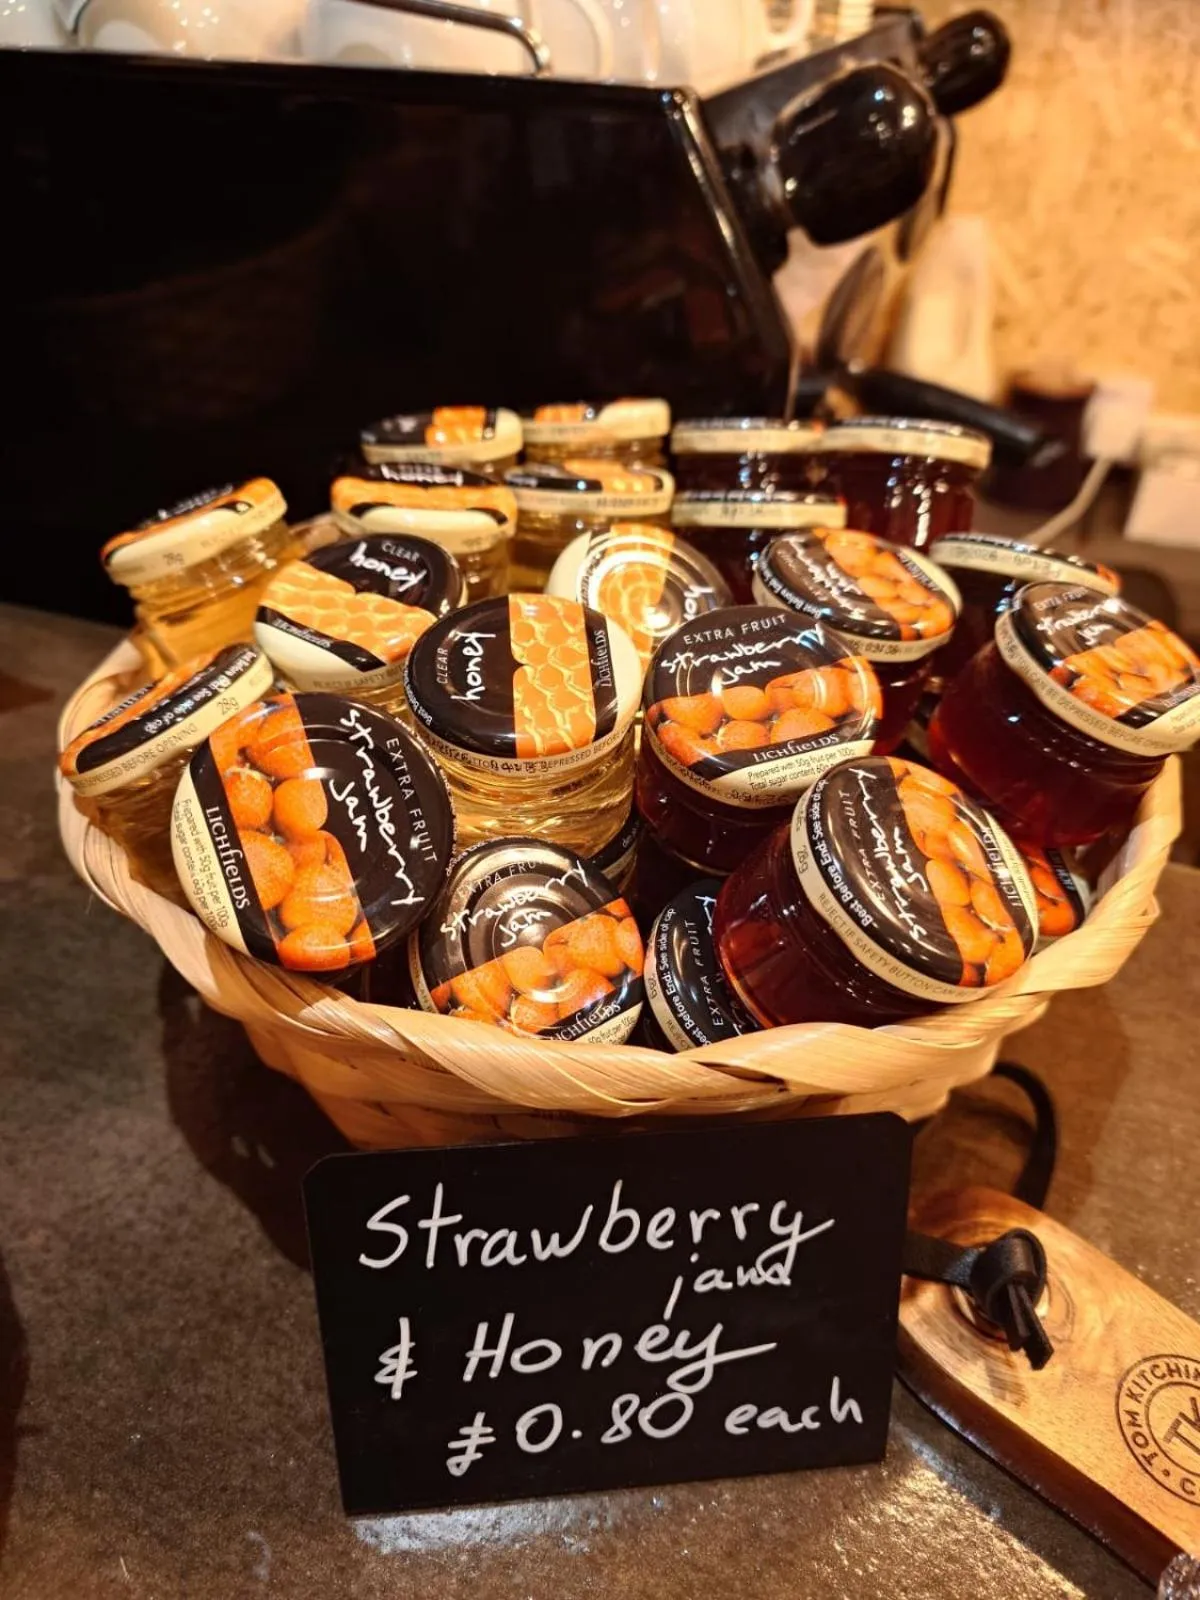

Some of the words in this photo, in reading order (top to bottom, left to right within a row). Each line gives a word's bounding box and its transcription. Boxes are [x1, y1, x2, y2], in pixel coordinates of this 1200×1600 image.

[350, 541, 427, 593] honey
[381, 541, 420, 563] CLEAR
[683, 625, 735, 645] EXTRA
[742, 613, 787, 635] FRUIT
[436, 646, 449, 685] CLEAR
[451, 631, 496, 701] honey
[121, 751, 157, 772] BEFORE
[157, 722, 200, 754] OPENING
[386, 738, 414, 801] EXTRA
[409, 807, 438, 863] FRUIT
[749, 781, 769, 793] Total
[768, 775, 788, 789] sugar
[809, 801, 821, 820] side
[811, 821, 824, 841] See
[838, 789, 861, 839] FRUIT
[199, 854, 212, 873] 50g
[210, 890, 223, 905] per
[827, 865, 854, 904] Before
[661, 923, 669, 932] of
[665, 907, 677, 923] cap
[849, 902, 873, 927] Best
[657, 935, 668, 951] side
[659, 953, 670, 972] See
[685, 919, 705, 967] FRUIT
[819, 893, 845, 929] REJECT
[844, 926, 856, 938] IF
[853, 935, 889, 968] SAFETY
[888, 965, 931, 990] BUTTON
[672, 993, 696, 1030] Before
[700, 975, 724, 1027] EXTRA
[359, 1179, 836, 1286] Strawberry
[374, 1316, 418, 1399] &
[462, 1312, 777, 1393] Honey
[724, 1375, 863, 1435] each
[1123, 1408, 1158, 1468] TOM
